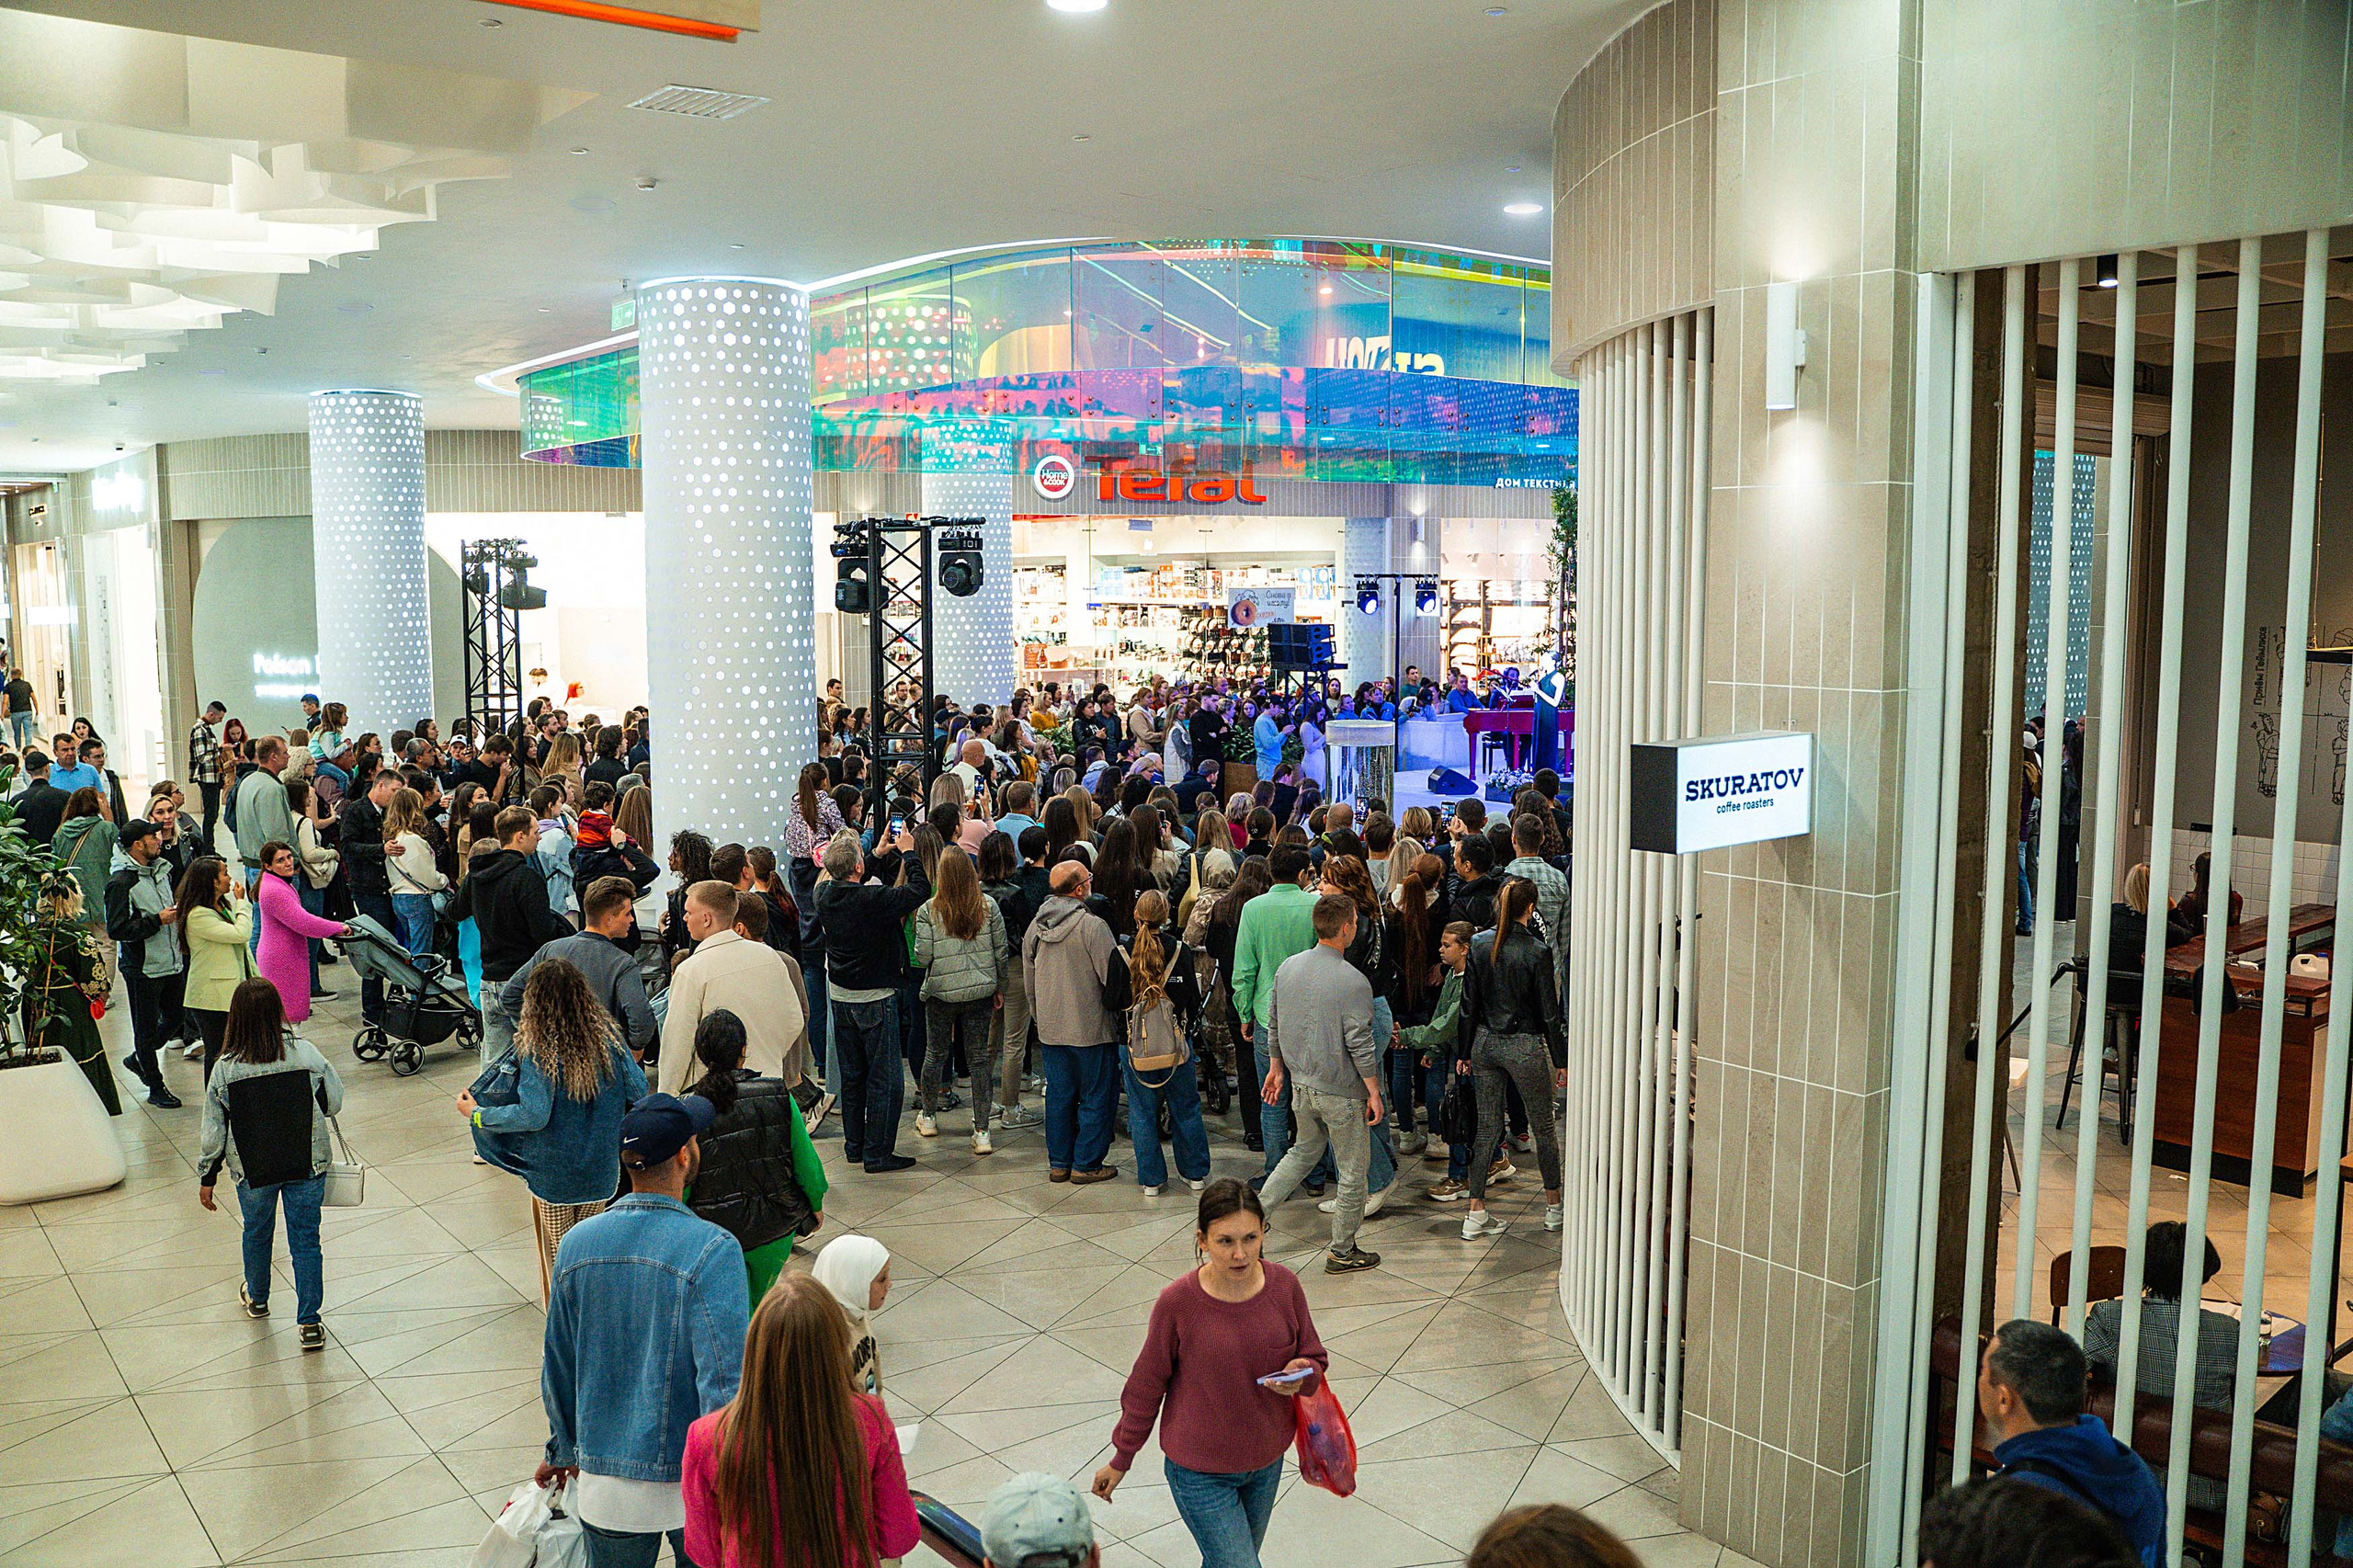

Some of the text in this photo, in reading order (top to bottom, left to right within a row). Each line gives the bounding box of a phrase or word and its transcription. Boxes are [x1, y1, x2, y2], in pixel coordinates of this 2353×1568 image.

[1041, 470, 1069, 480] Home
[1085, 456, 1267, 503] Tefal
[1495, 478, 1520, 489] ДОМ
[1686, 767, 1804, 802] SKURATOV
[1716, 798, 1774, 813] coffee roasters
